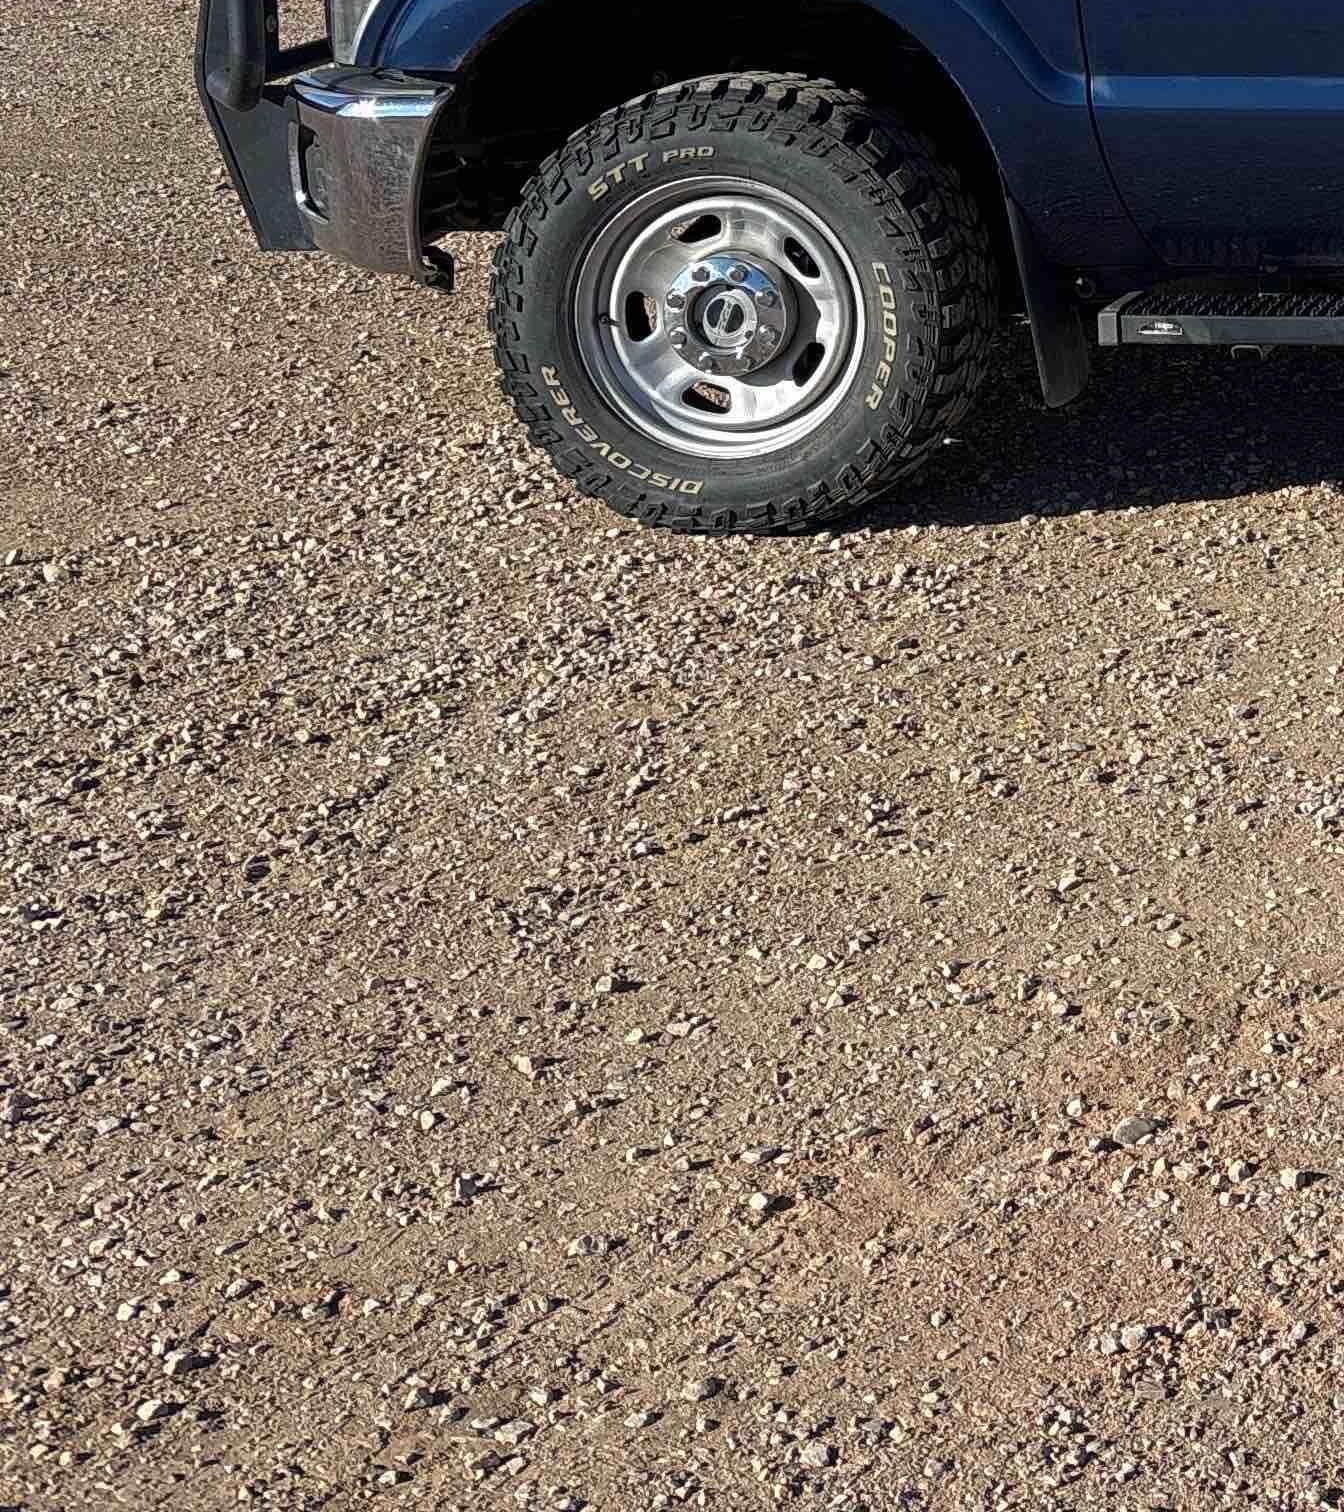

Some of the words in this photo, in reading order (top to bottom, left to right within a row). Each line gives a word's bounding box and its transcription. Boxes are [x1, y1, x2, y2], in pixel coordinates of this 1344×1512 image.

[588, 152, 649, 201] STT
[662, 146, 714, 163] PRO
[865, 261, 900, 412] COOPER
[541, 365, 704, 497] DISCOVERER
